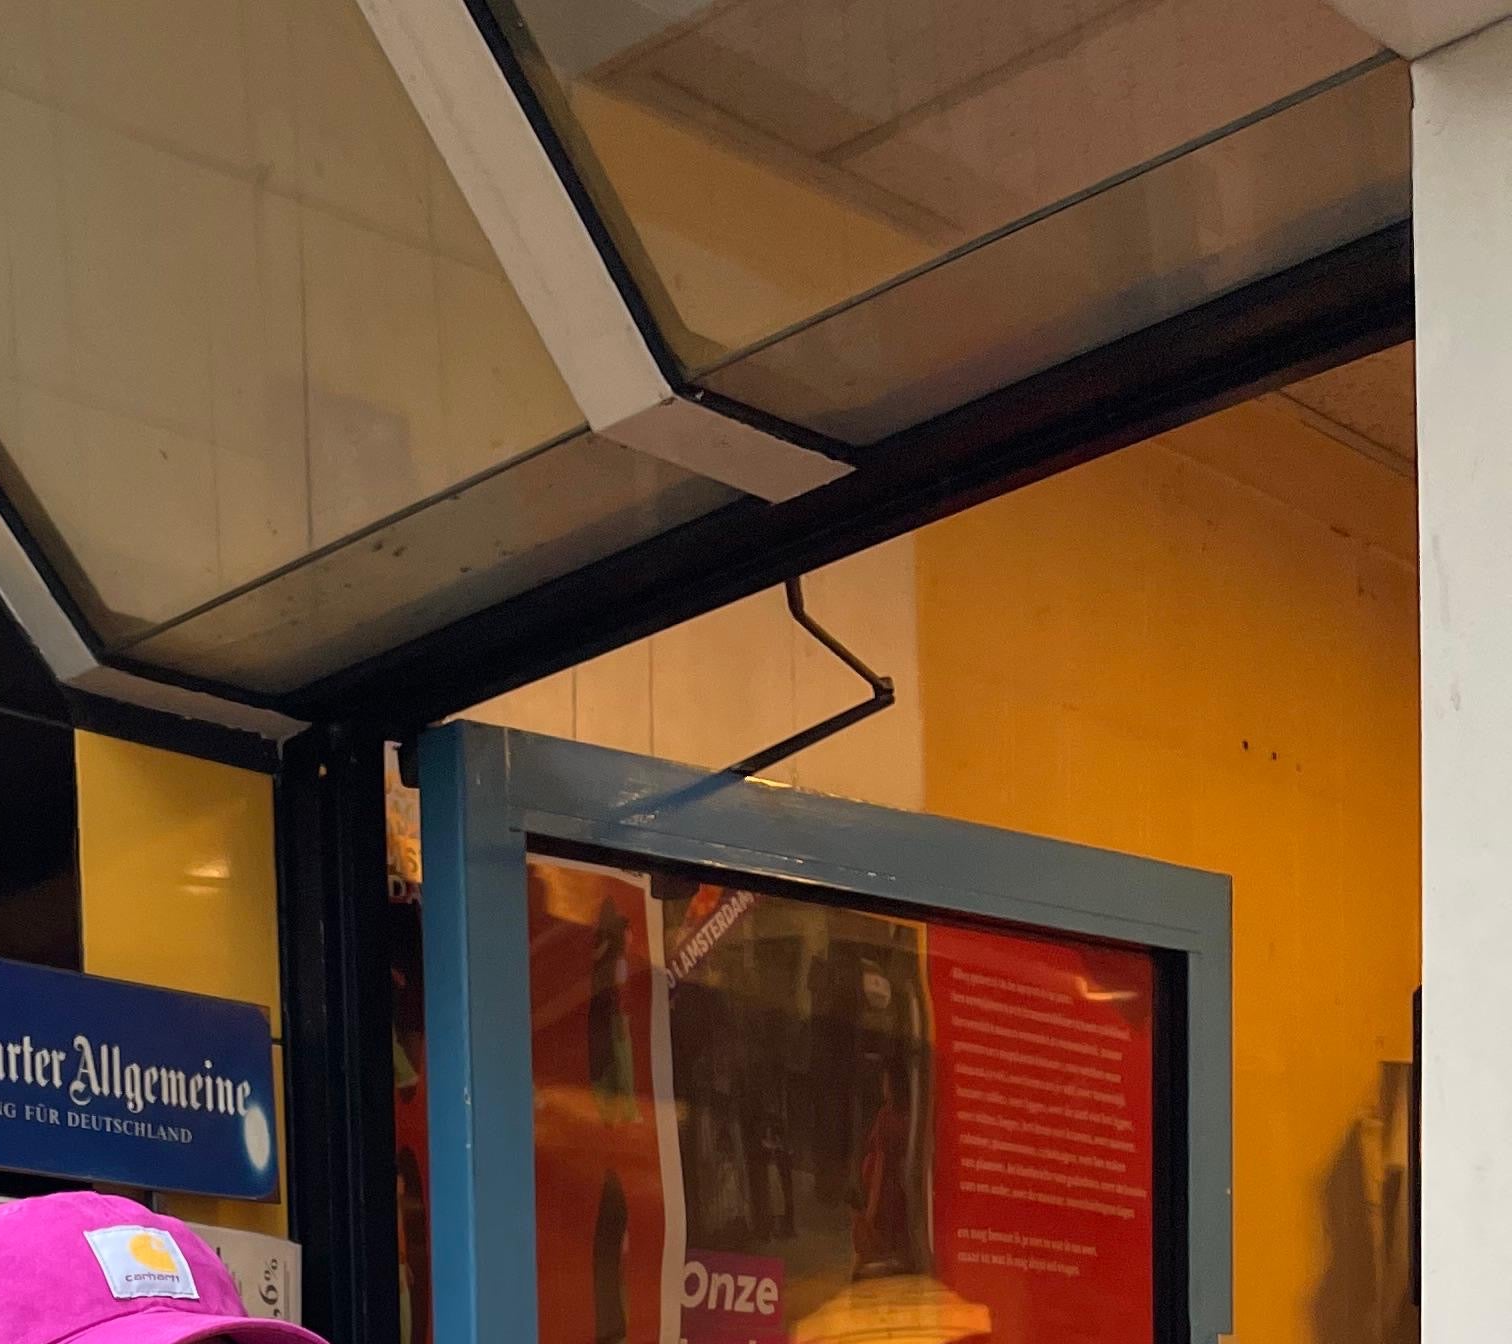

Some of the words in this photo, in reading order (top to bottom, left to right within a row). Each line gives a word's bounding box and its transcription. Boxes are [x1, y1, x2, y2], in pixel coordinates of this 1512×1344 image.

[679, 889, 755, 974] AMSTERDAM
[70, 1034, 251, 1115] Allgemeine
[25, 1104, 61, 1126] FÜR
[67, 1111, 193, 1144] DEUTSCHLAND
[682, 1260, 779, 1315] Onze
